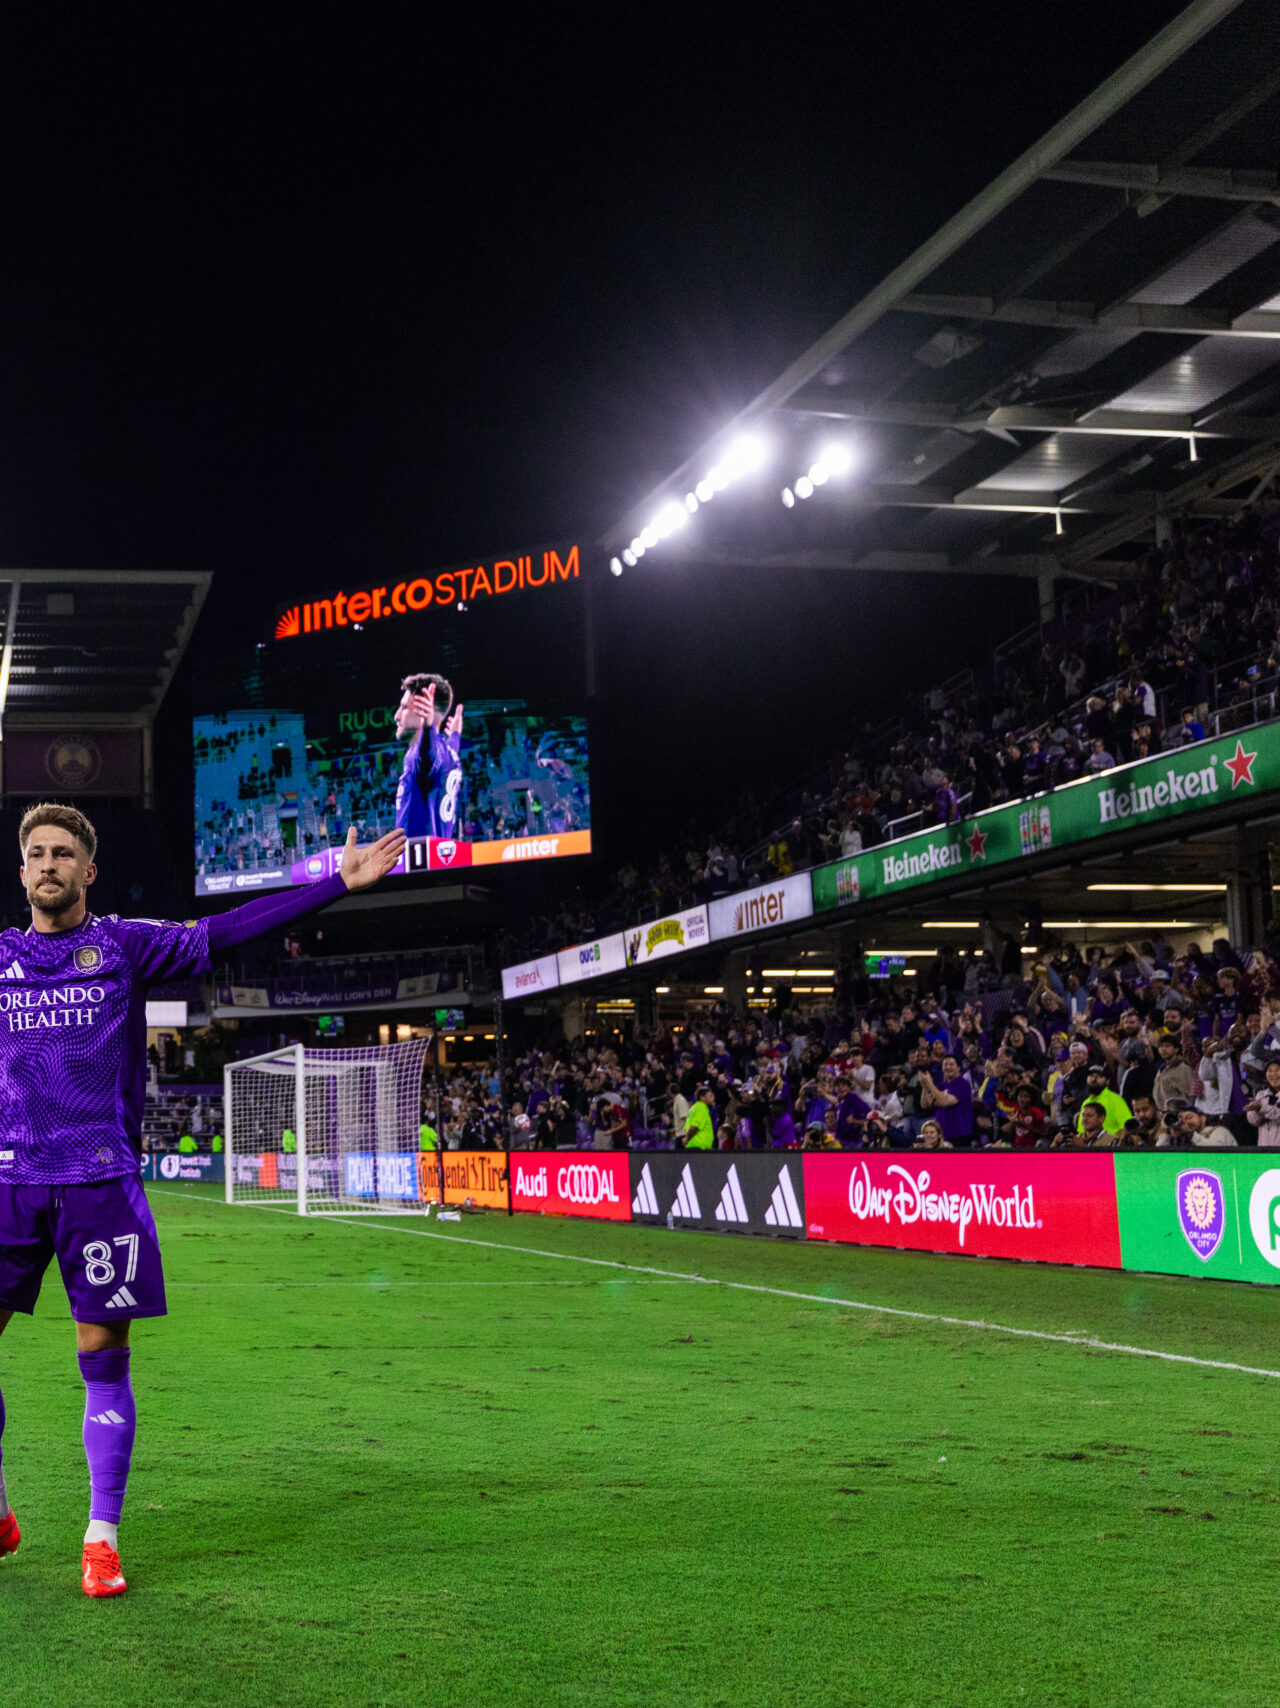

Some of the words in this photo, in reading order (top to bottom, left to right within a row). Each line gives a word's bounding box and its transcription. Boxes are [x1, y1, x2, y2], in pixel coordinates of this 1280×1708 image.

[435, 546, 579, 605] STADIUM
[1098, 766, 1219, 824] Heineken
[414, 843, 422, 866] 1
[882, 843, 962, 885] Heineken
[686, 914, 705, 928] OFFICIAL
[688, 927, 706, 940] MOVERS
[373, 988, 392, 999] DEN
[8, 1007, 94, 1032] HEALTH
[478, 1157, 505, 1193] Tire
[515, 1166, 548, 1197] Audi
[969, 1184, 1037, 1229] World
[1188, 1230, 1218, 1241] ORLANDO
[1197, 1240, 1210, 1249] CITY
[82, 1233, 139, 1286] 87
